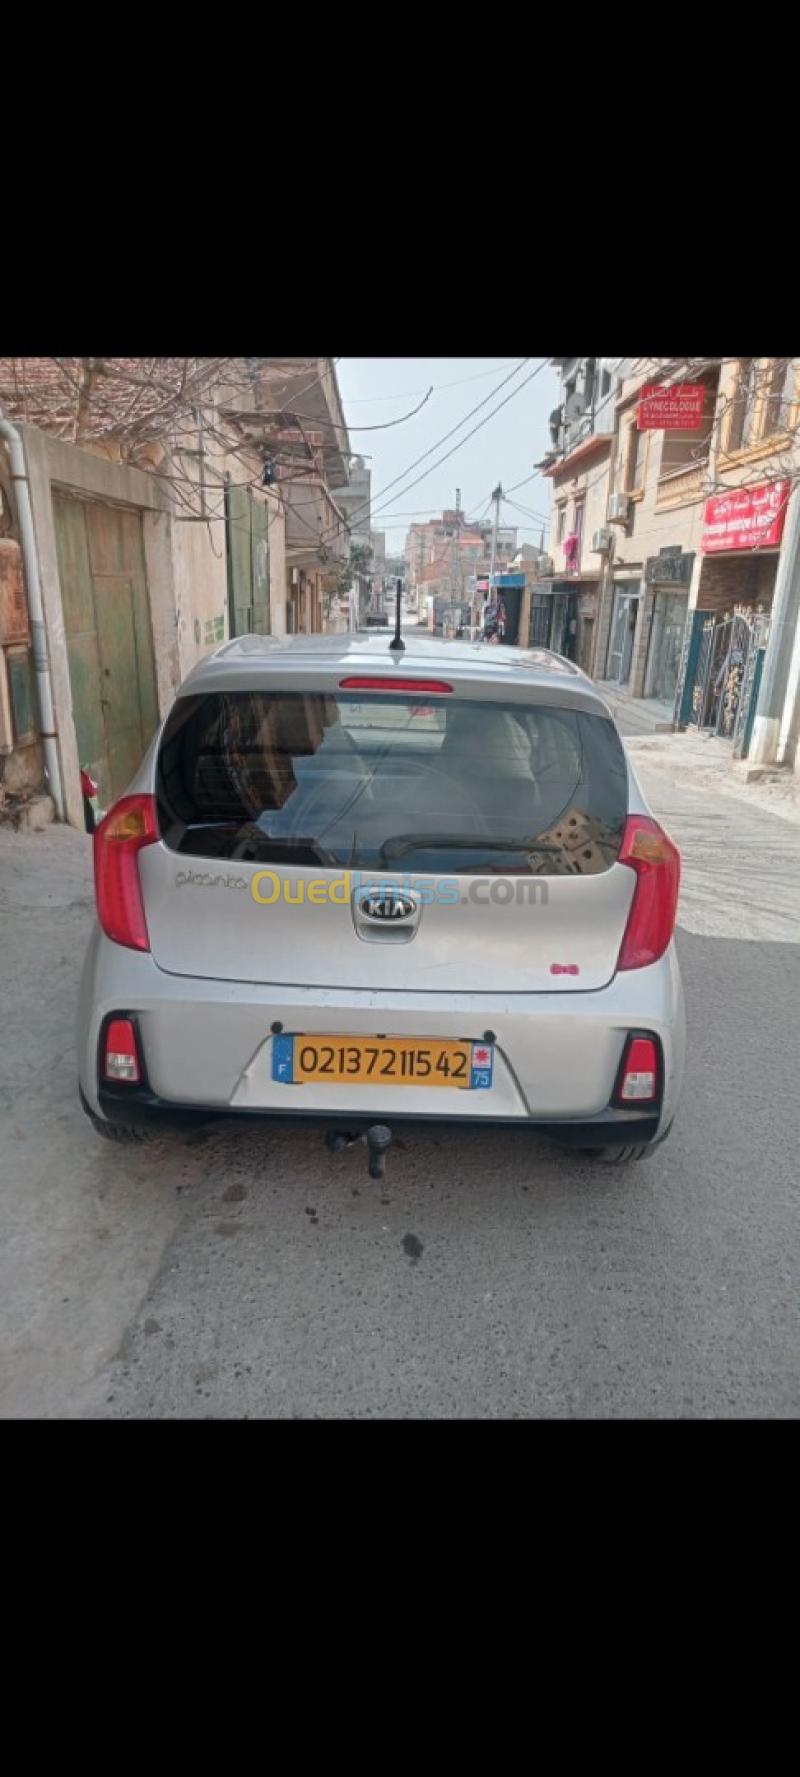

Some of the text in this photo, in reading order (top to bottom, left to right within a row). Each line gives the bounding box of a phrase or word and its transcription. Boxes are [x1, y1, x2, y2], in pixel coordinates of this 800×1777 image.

[368, 898, 406, 916] KIA
[278, 1063, 286, 1075] F
[473, 1070, 489, 1086] 75
